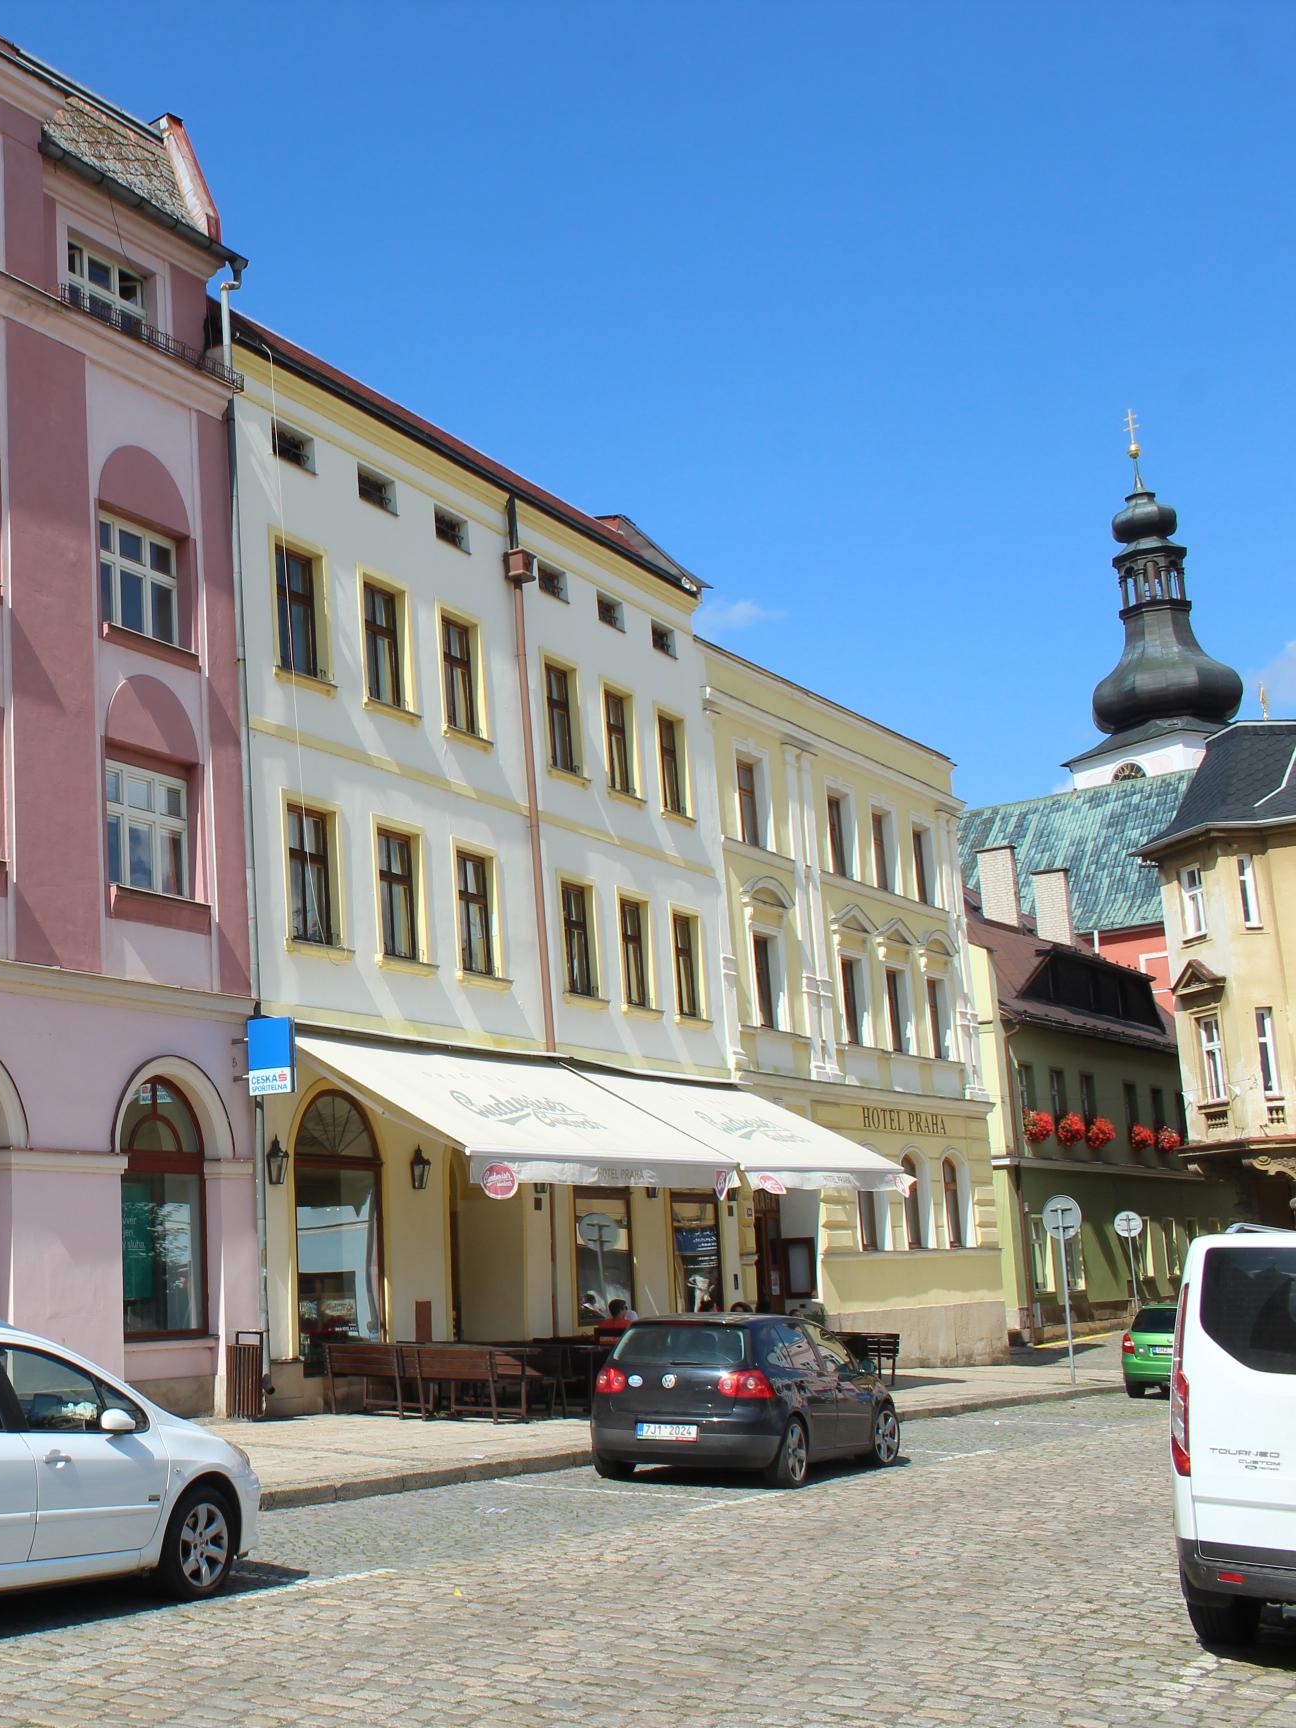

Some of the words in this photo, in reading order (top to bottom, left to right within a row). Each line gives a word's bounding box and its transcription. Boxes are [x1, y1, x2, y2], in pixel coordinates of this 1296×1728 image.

[251, 1074, 278, 1085] ČESKÁ
[251, 1083, 288, 1093] SPOŘITELNA
[862, 1107, 904, 1131] HOTEL
[907, 1112, 947, 1135] PRAHA
[645, 1424, 662, 1435] 7J1
[669, 1425, 692, 1436] 2024
[1209, 1447, 1280, 1458] TOURNEO
